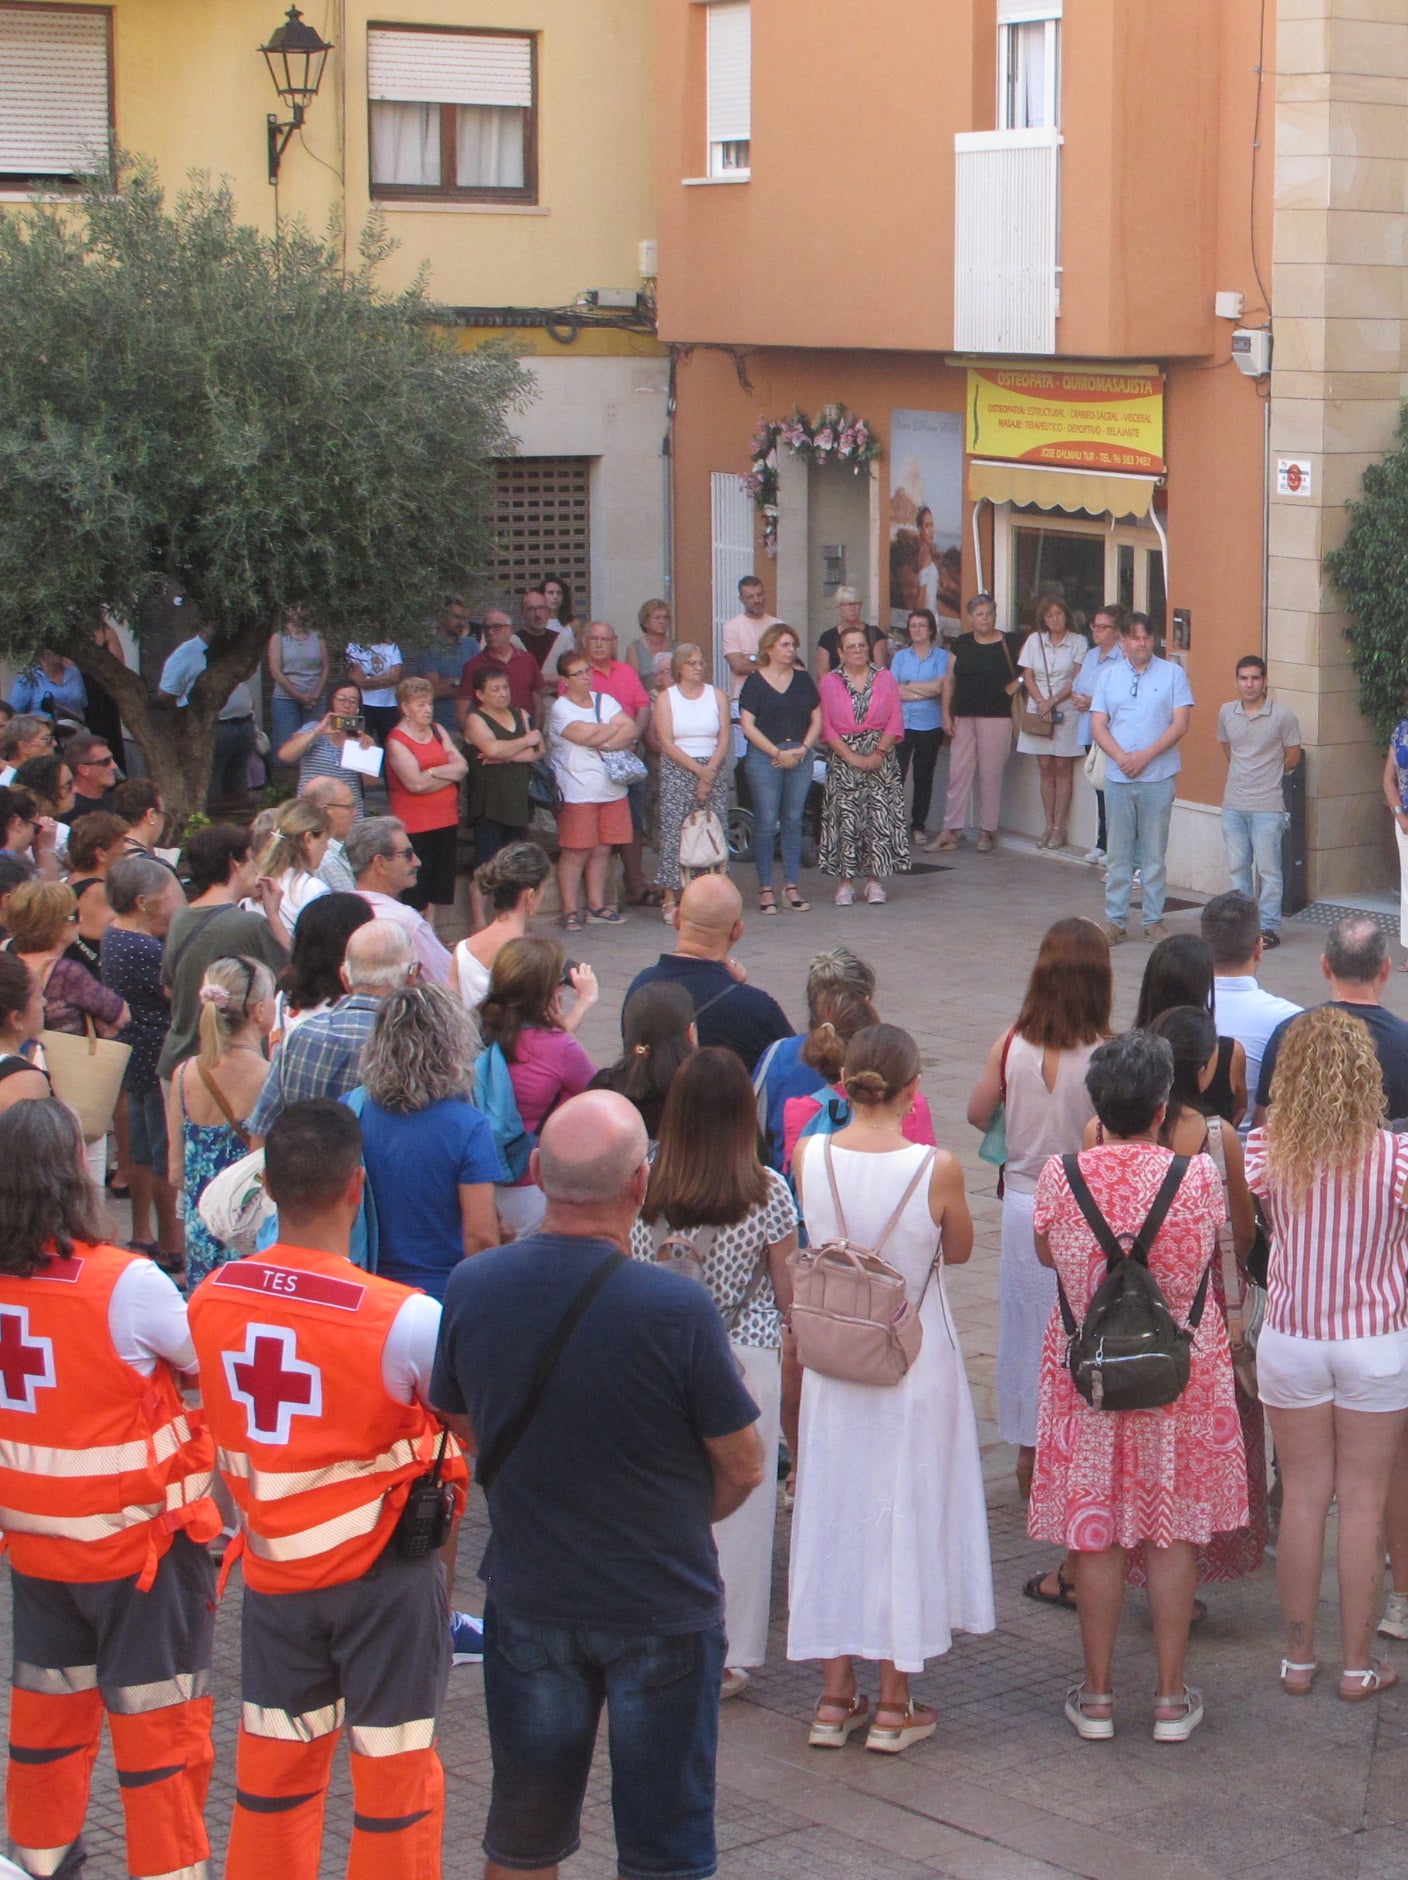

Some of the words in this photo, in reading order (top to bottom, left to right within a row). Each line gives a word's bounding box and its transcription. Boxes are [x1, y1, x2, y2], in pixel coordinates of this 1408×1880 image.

[998, 372, 1054, 388] OSTEOPATA
[1063, 375, 1153, 394] QUIROMASAJISTA
[263, 1270, 298, 1292] TES
